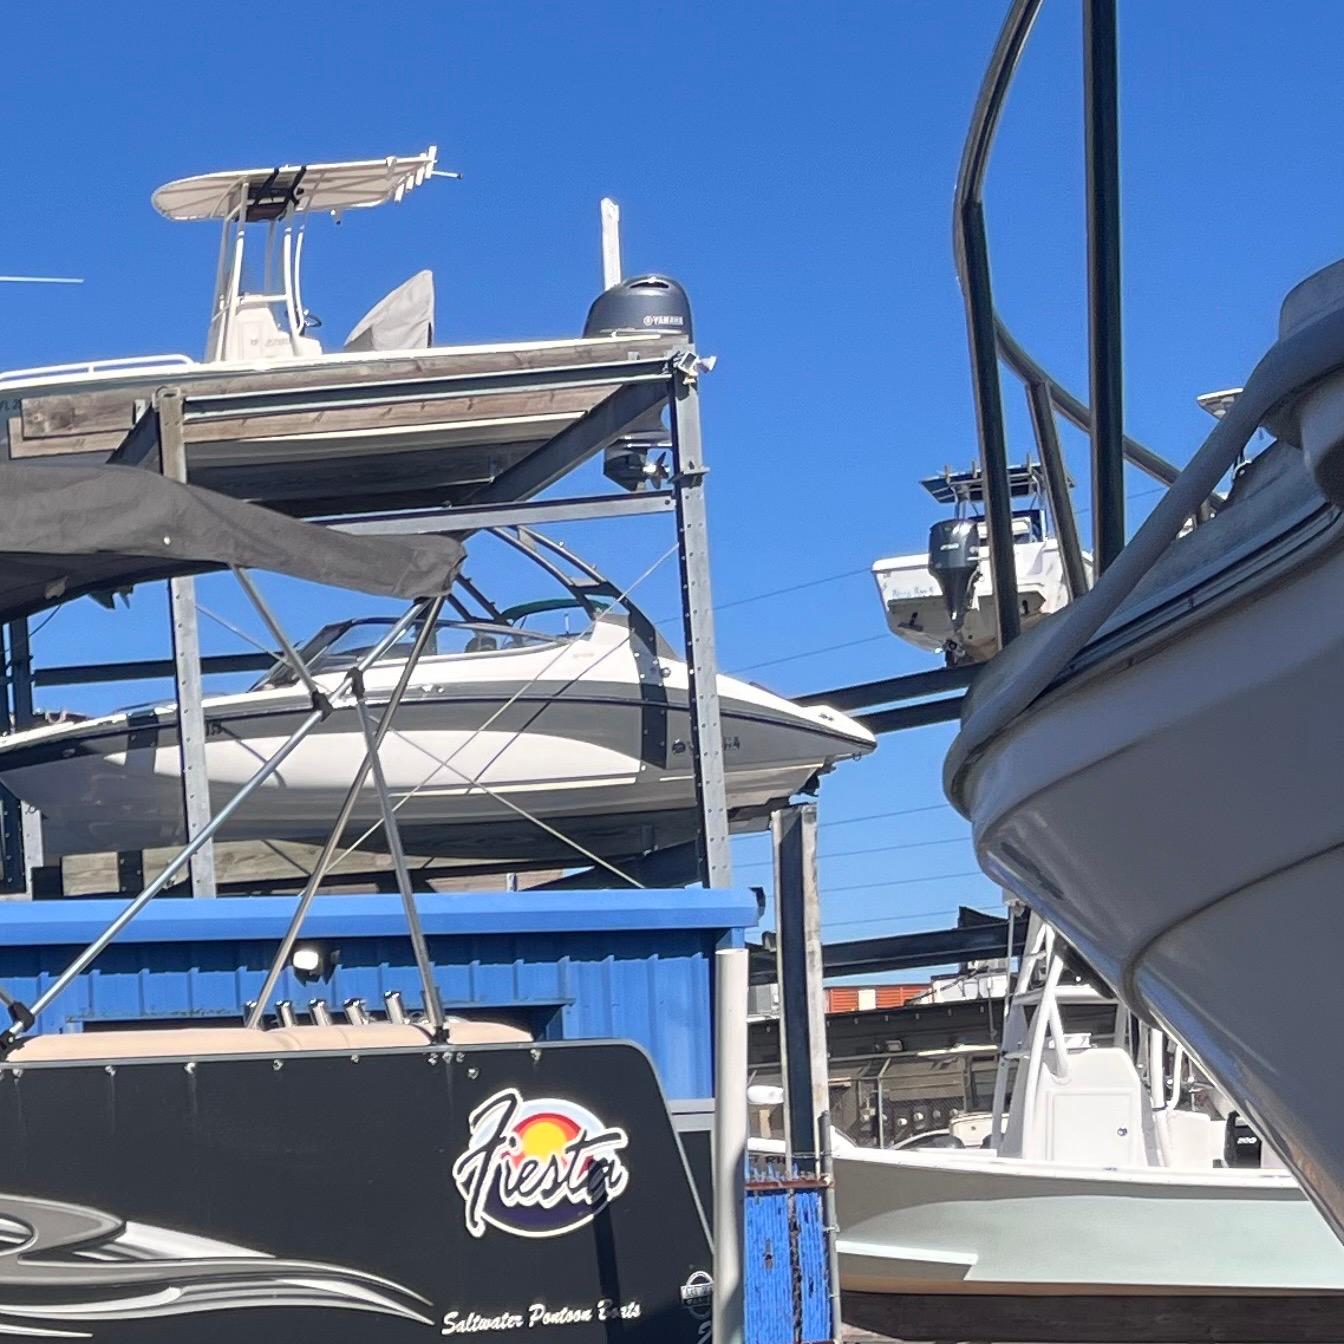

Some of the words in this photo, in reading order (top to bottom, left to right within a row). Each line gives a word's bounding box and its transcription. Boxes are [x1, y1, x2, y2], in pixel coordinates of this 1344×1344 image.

[453, 1088, 628, 1237] Fiesta
[441, 1311, 523, 1335] Saltwater
[528, 1303, 593, 1327] Pontoon
[597, 1298, 641, 1320] Boats
